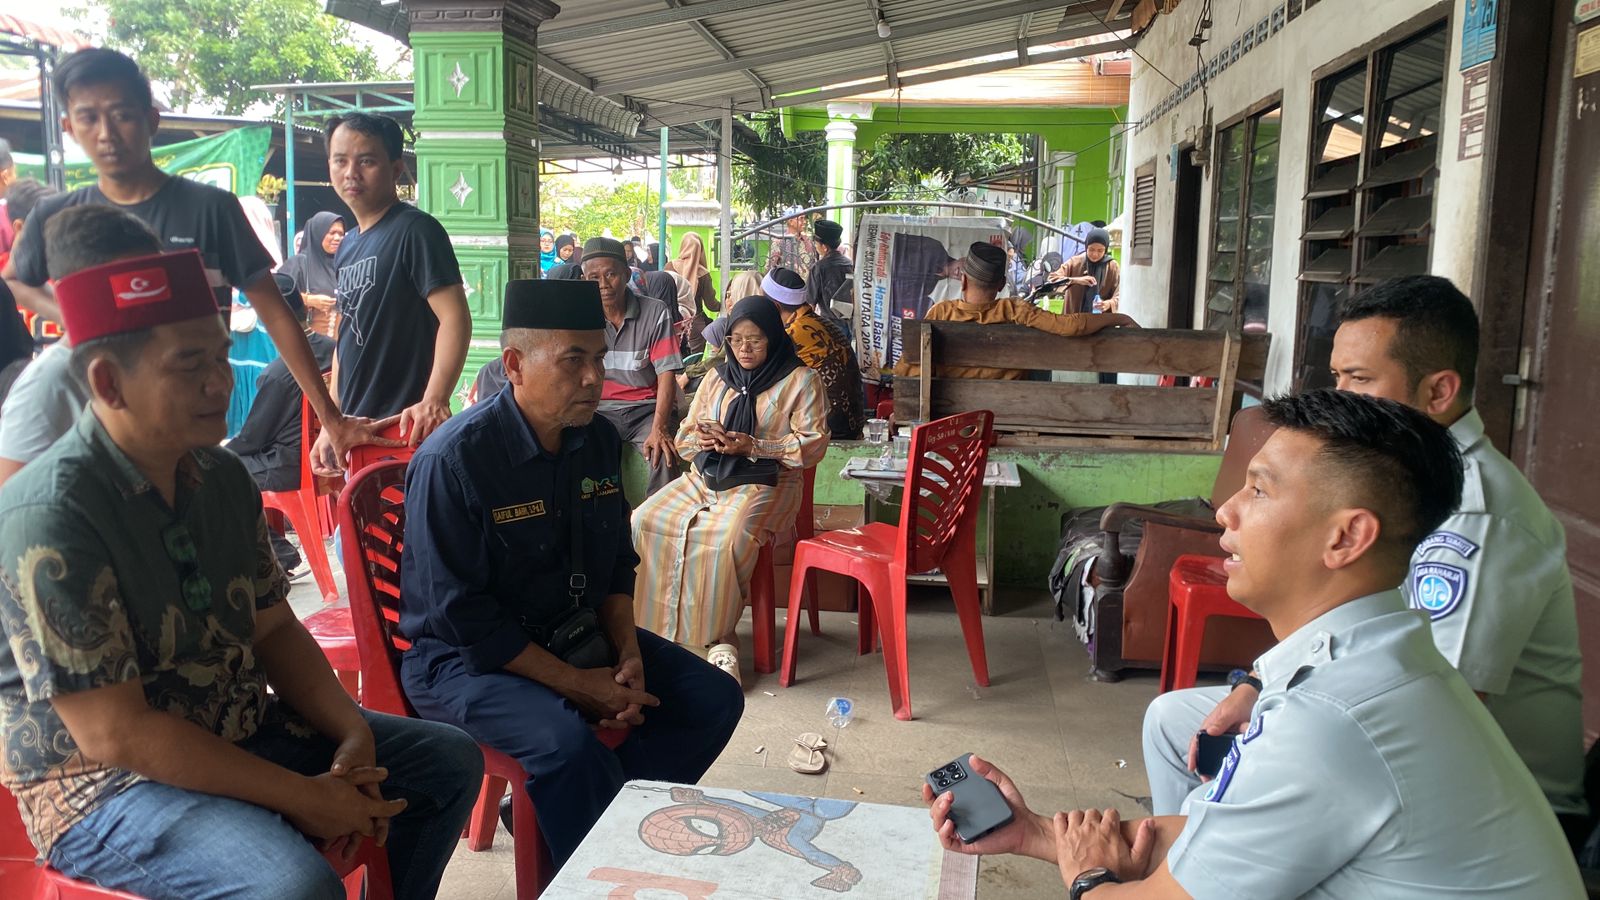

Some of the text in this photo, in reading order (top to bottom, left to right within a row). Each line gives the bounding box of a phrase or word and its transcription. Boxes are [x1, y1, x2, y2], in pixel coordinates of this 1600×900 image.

[878, 231, 891, 241] Edy
[862, 250, 875, 289] SUMATERA
[861, 293, 872, 328] UTARA
[874, 285, 886, 321] Hasan
[872, 321, 884, 350] Basri
[1428, 566, 1460, 583] RAHARJA
